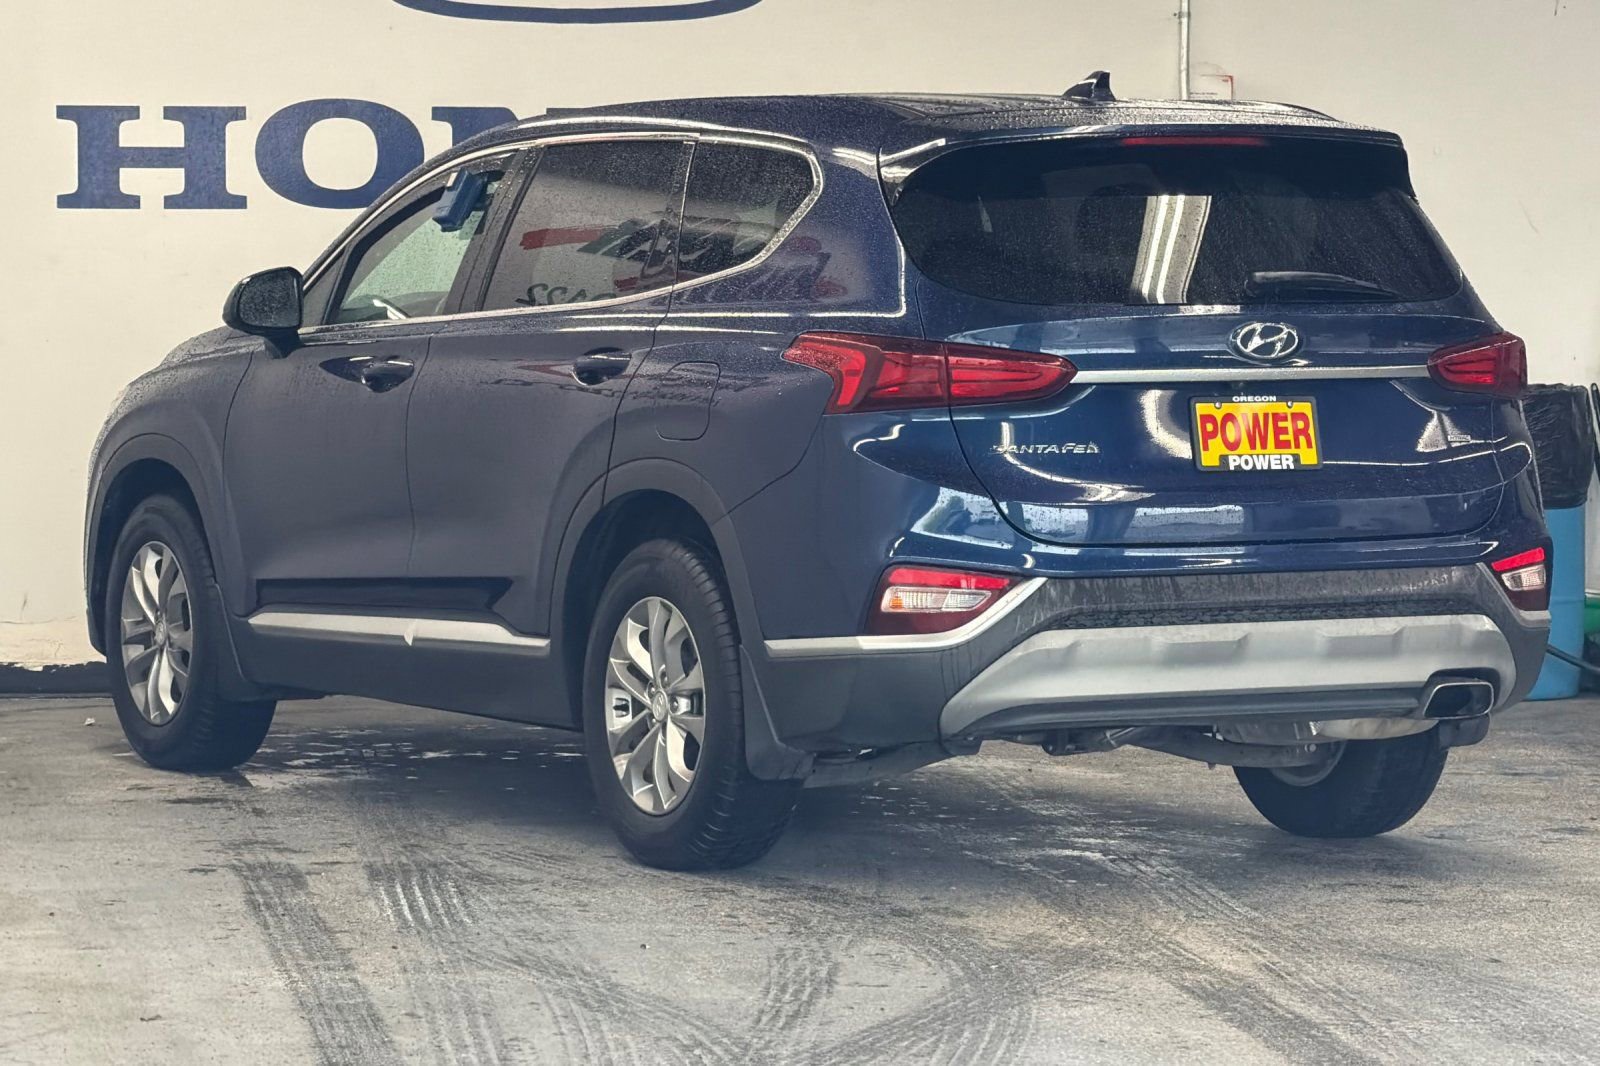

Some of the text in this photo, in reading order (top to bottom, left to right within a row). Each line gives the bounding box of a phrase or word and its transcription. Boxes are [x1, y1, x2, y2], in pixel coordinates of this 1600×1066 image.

[56, 98, 580, 209] HO
[1199, 412, 1313, 452] POWER
[1228, 454, 1294, 471] POWER
